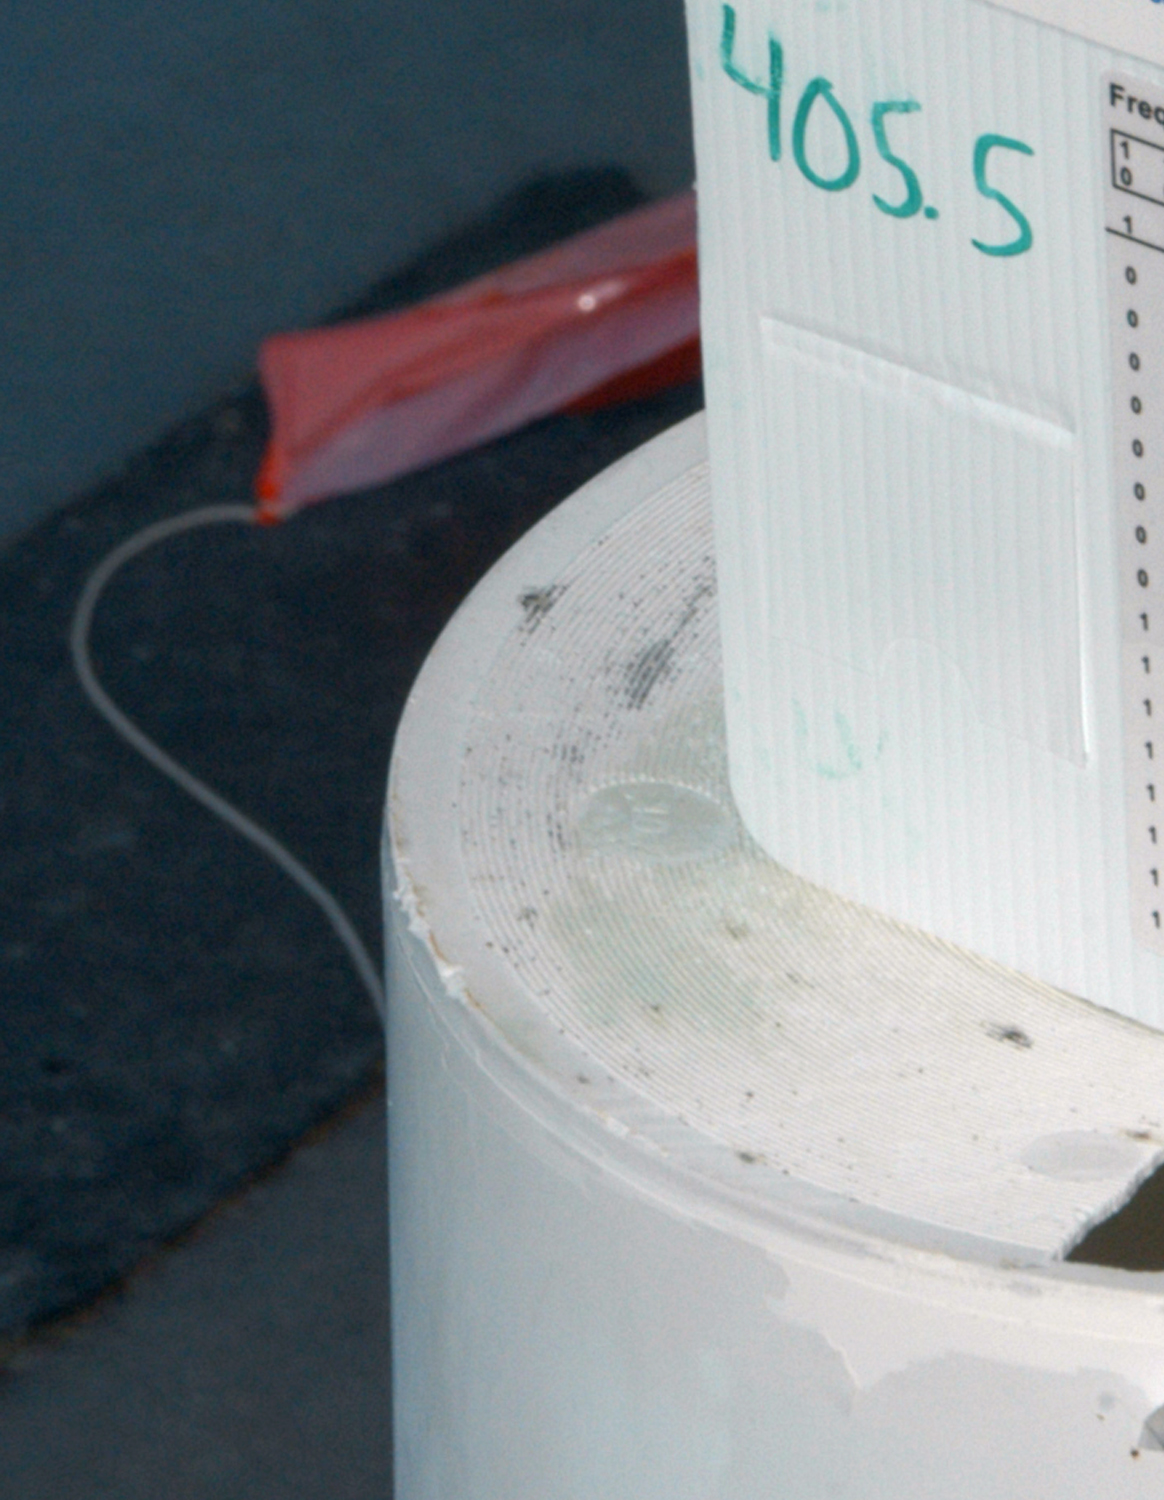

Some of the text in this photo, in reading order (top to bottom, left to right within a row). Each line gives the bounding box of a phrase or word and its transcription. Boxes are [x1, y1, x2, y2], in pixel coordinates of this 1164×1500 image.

[1119, 139, 1130, 160] 1
[1122, 214, 1133, 235] 1
[1140, 612, 1148, 631] 1
[1141, 656, 1150, 674] 1
[1143, 698, 1152, 716] 1
[1145, 741, 1153, 759] 1
[1146, 783, 1155, 802] 1
[1148, 826, 1157, 844] 1
[1150, 868, 1159, 886] 1
[1152, 910, 1160, 929] 1
